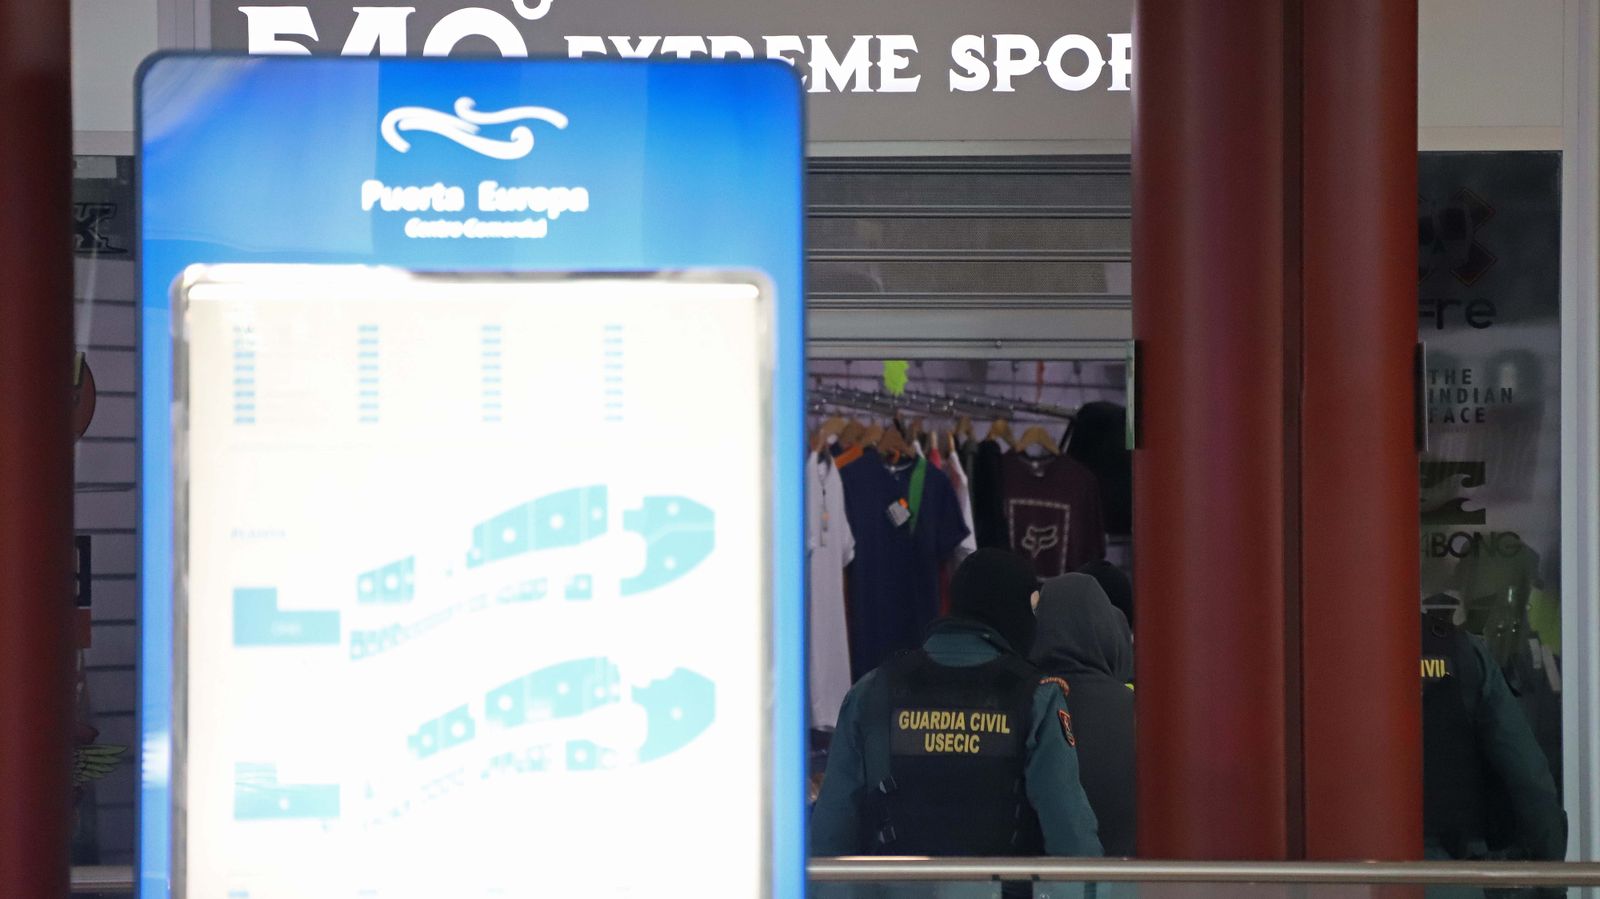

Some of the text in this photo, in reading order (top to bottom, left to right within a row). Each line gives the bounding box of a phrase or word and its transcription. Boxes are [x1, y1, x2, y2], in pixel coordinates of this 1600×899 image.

[361, 179, 590, 220] Puerta Europa
[1429, 368, 1472, 385] THE
[1429, 388, 1513, 404] INDIAN
[899, 710, 1010, 734] GUARDIA CIVIL
[925, 733, 980, 753] USECIC
